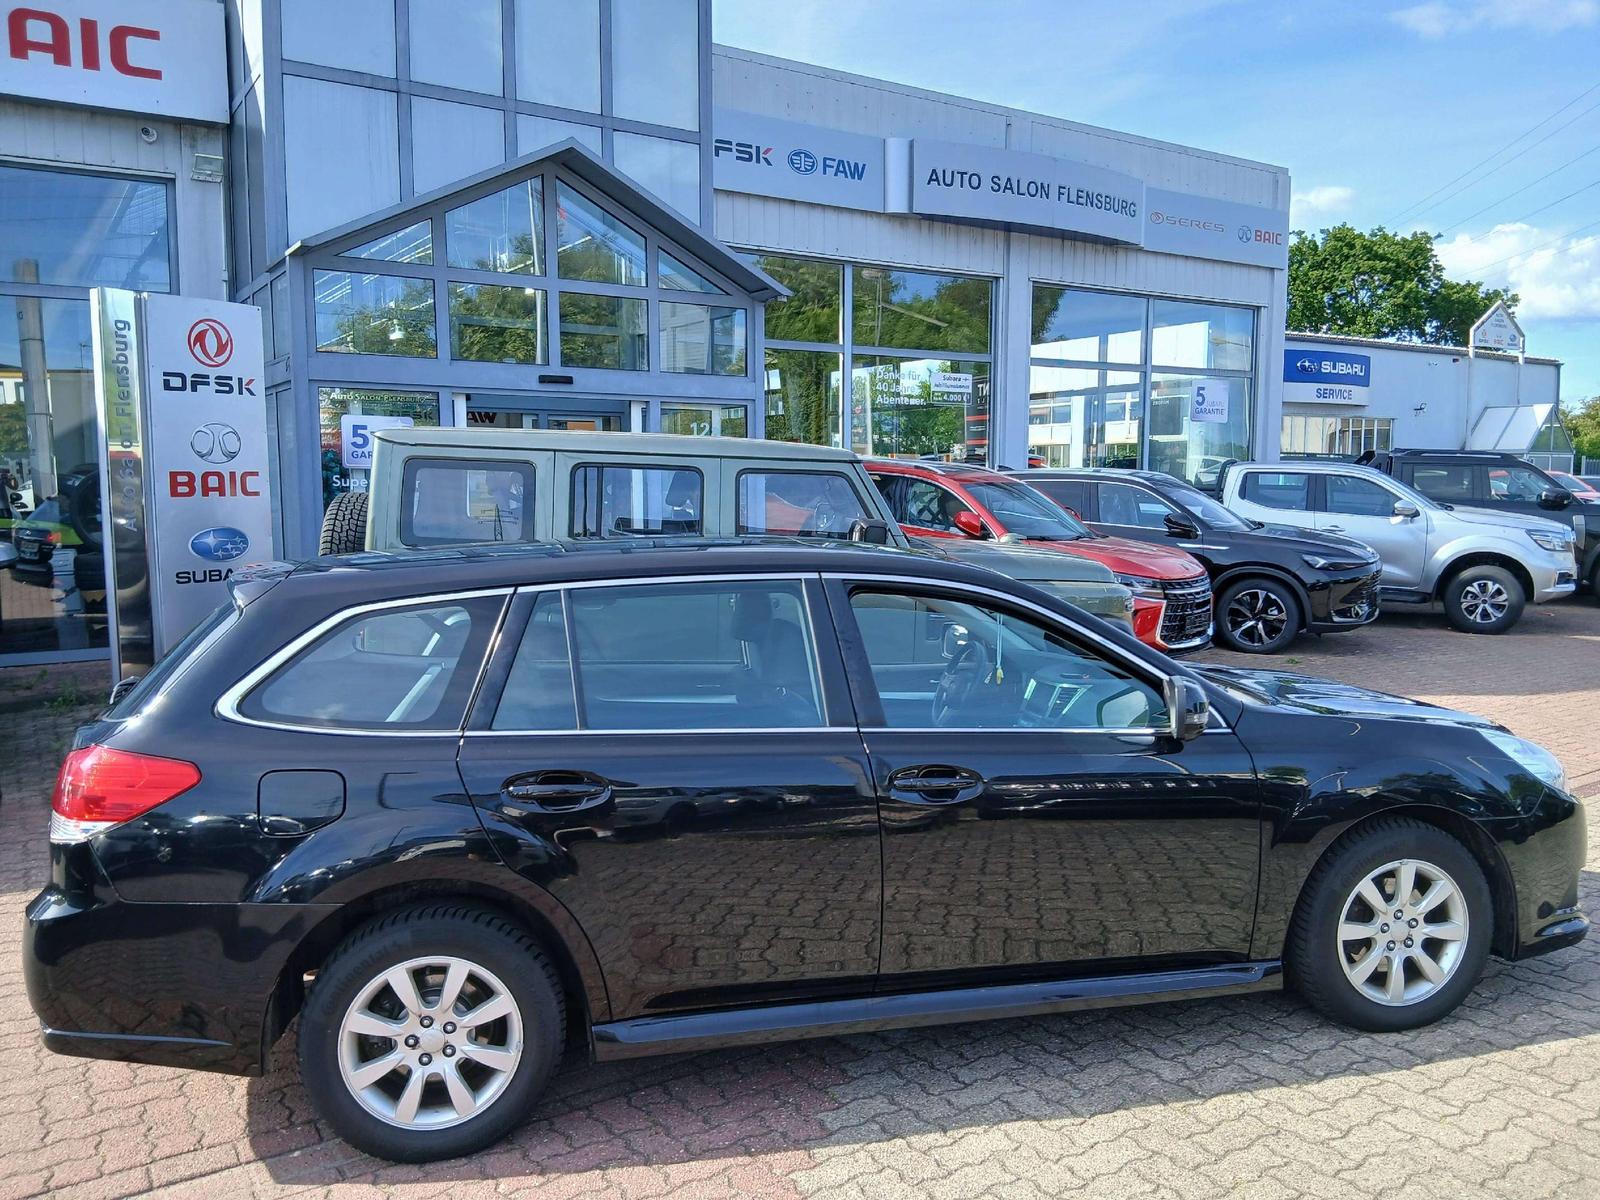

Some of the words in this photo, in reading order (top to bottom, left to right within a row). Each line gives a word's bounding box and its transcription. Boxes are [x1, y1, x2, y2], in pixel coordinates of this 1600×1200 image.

[8, 8, 162, 80] AIC
[714, 139, 774, 166] FSK
[823, 157, 866, 181] FAW
[927, 168, 982, 190] AUTO
[990, 175, 1050, 200] SALON
[1058, 186, 1137, 218] FLENSBURG
[1166, 215, 1225, 233] SERES
[1254, 230, 1282, 246] BAIC
[112, 320, 132, 417] Flensburg
[876, 369, 905, 380] Danke
[1321, 361, 1366, 377] SUBARU
[163, 371, 256, 397] DFSK
[876, 382, 888, 392] 40
[890, 383, 915, 393] Jahre
[1316, 387, 1353, 401] SERVICE
[1195, 386, 1206, 407] 5
[1195, 408, 1225, 416] GARANTIE
[350, 424, 370, 449] 5
[169, 470, 261, 498] BAIC
